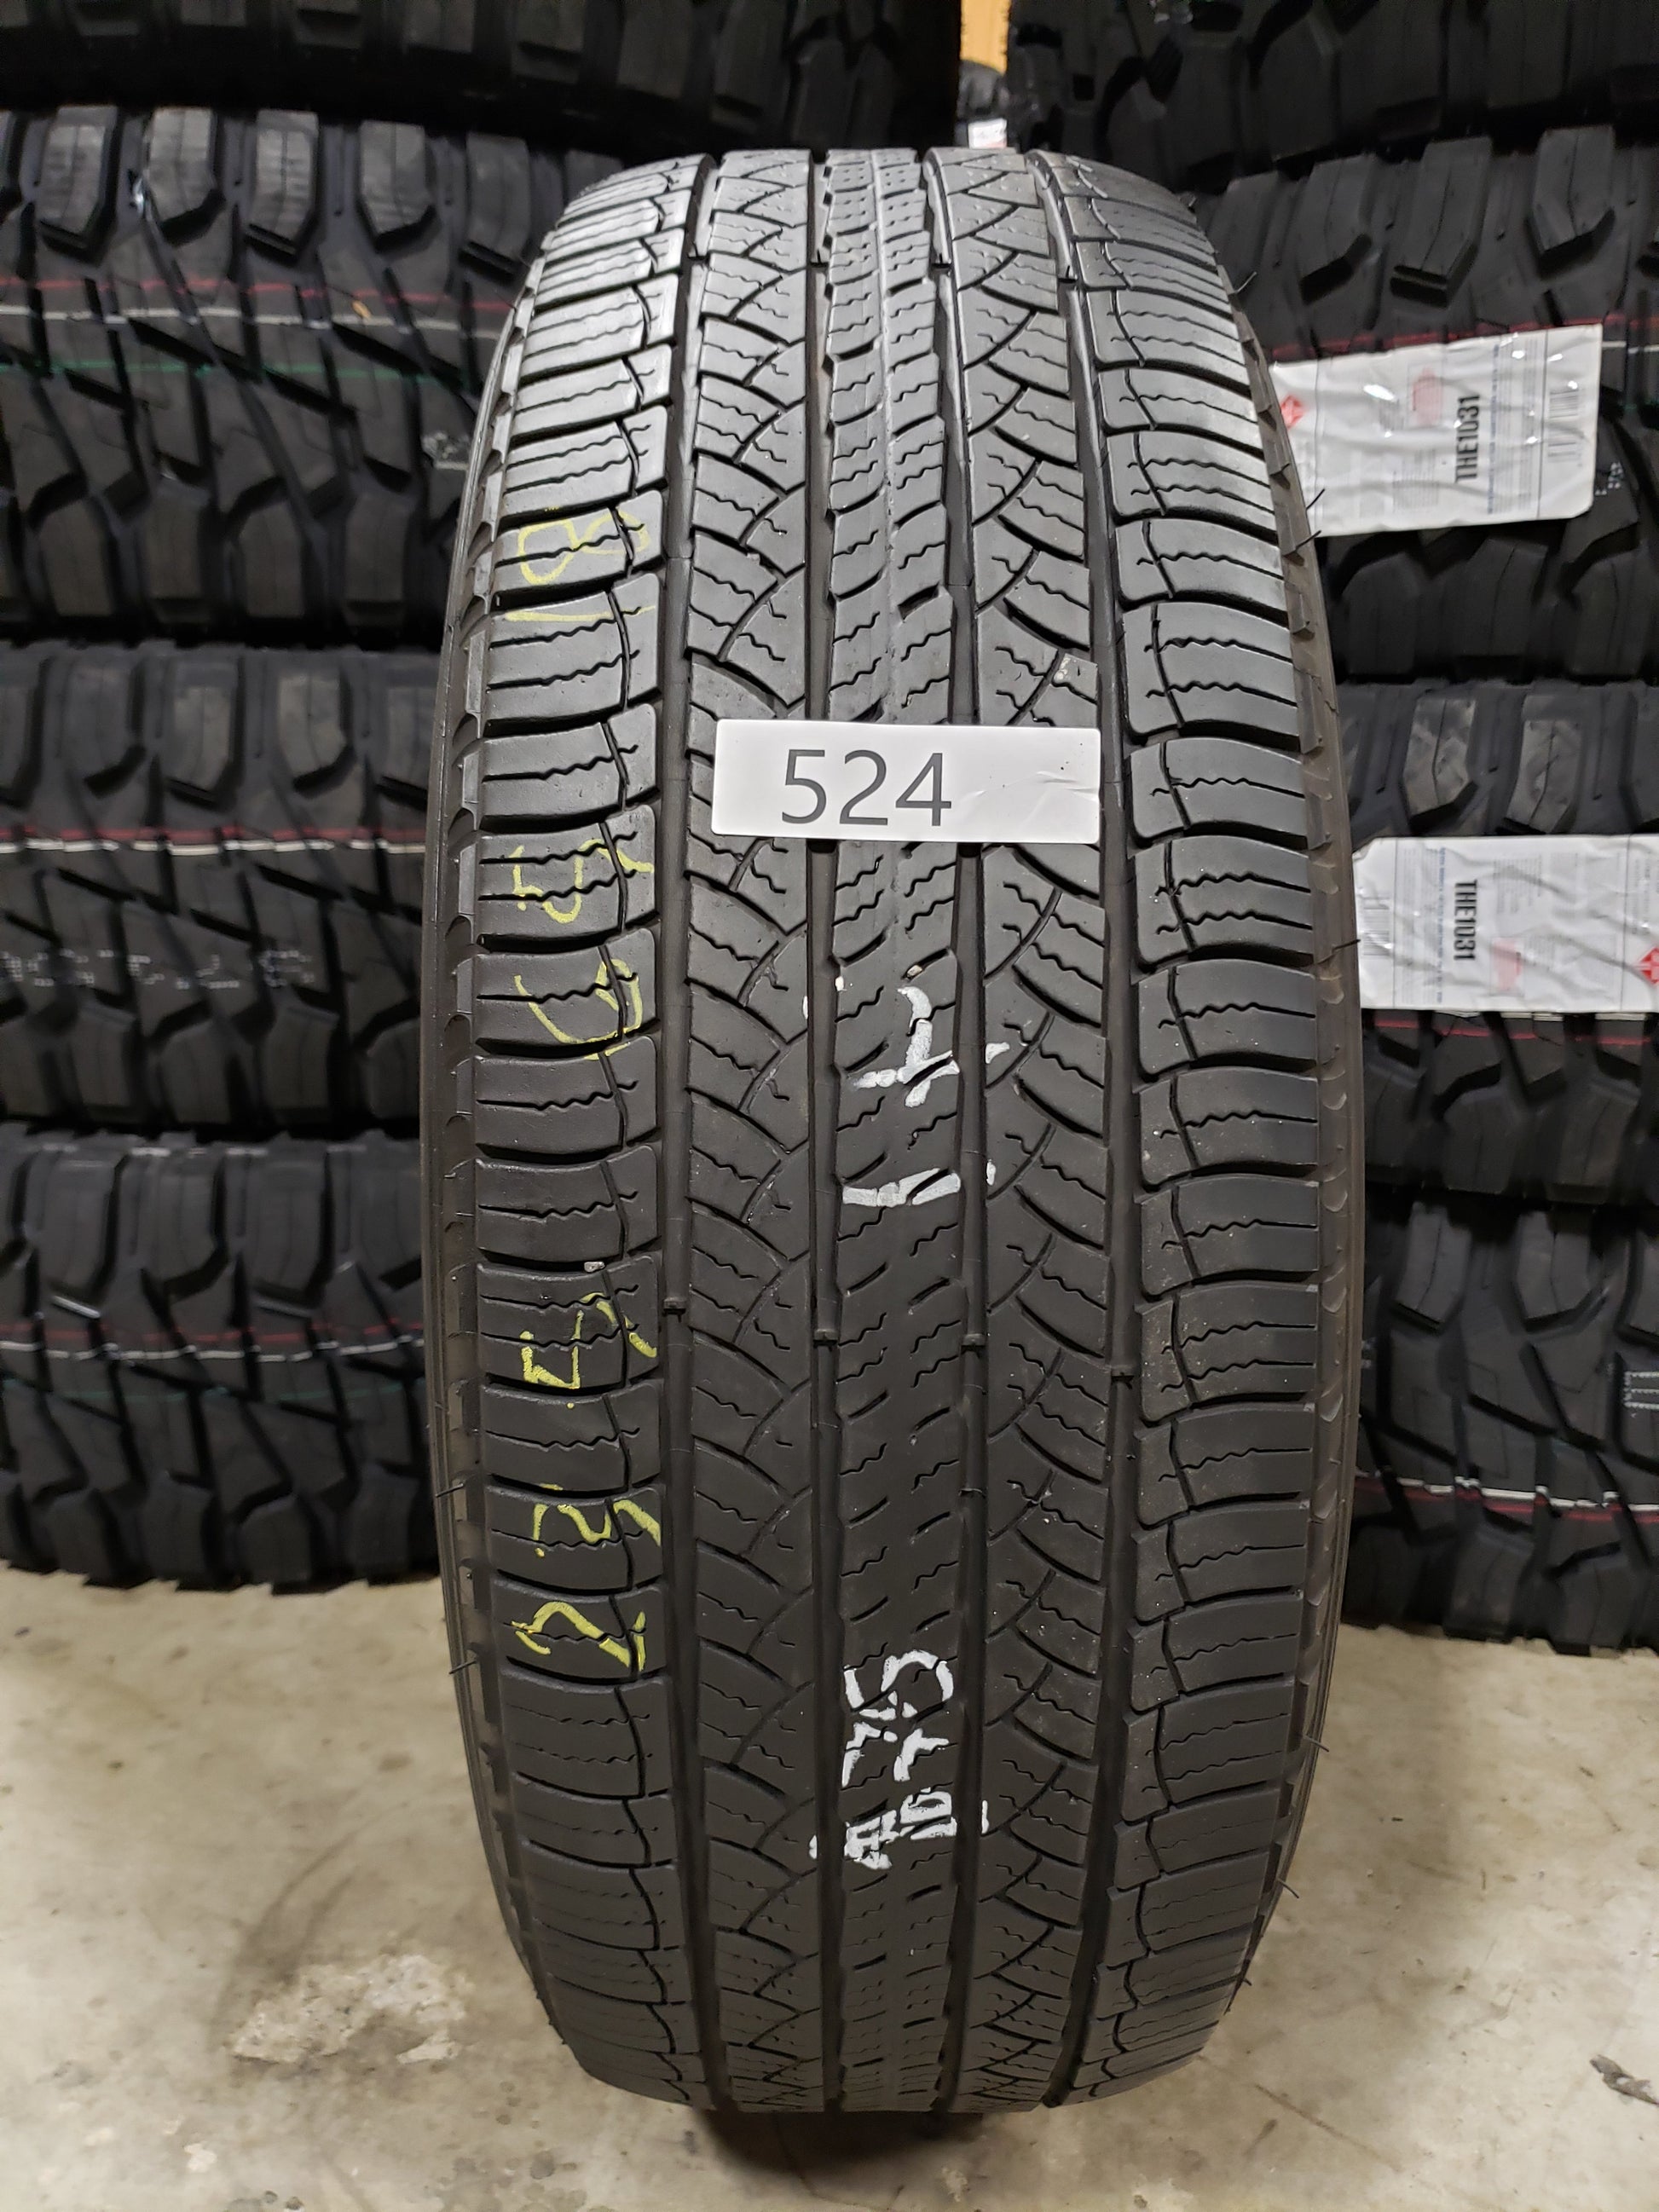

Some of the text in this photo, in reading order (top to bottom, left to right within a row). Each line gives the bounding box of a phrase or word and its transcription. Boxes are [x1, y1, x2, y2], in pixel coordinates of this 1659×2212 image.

[1454, 394, 1481, 483] THE1031
[505, 508, 655, 622] 18
[781, 749, 952, 827] 524
[1454, 880, 1477, 961] THE1031
